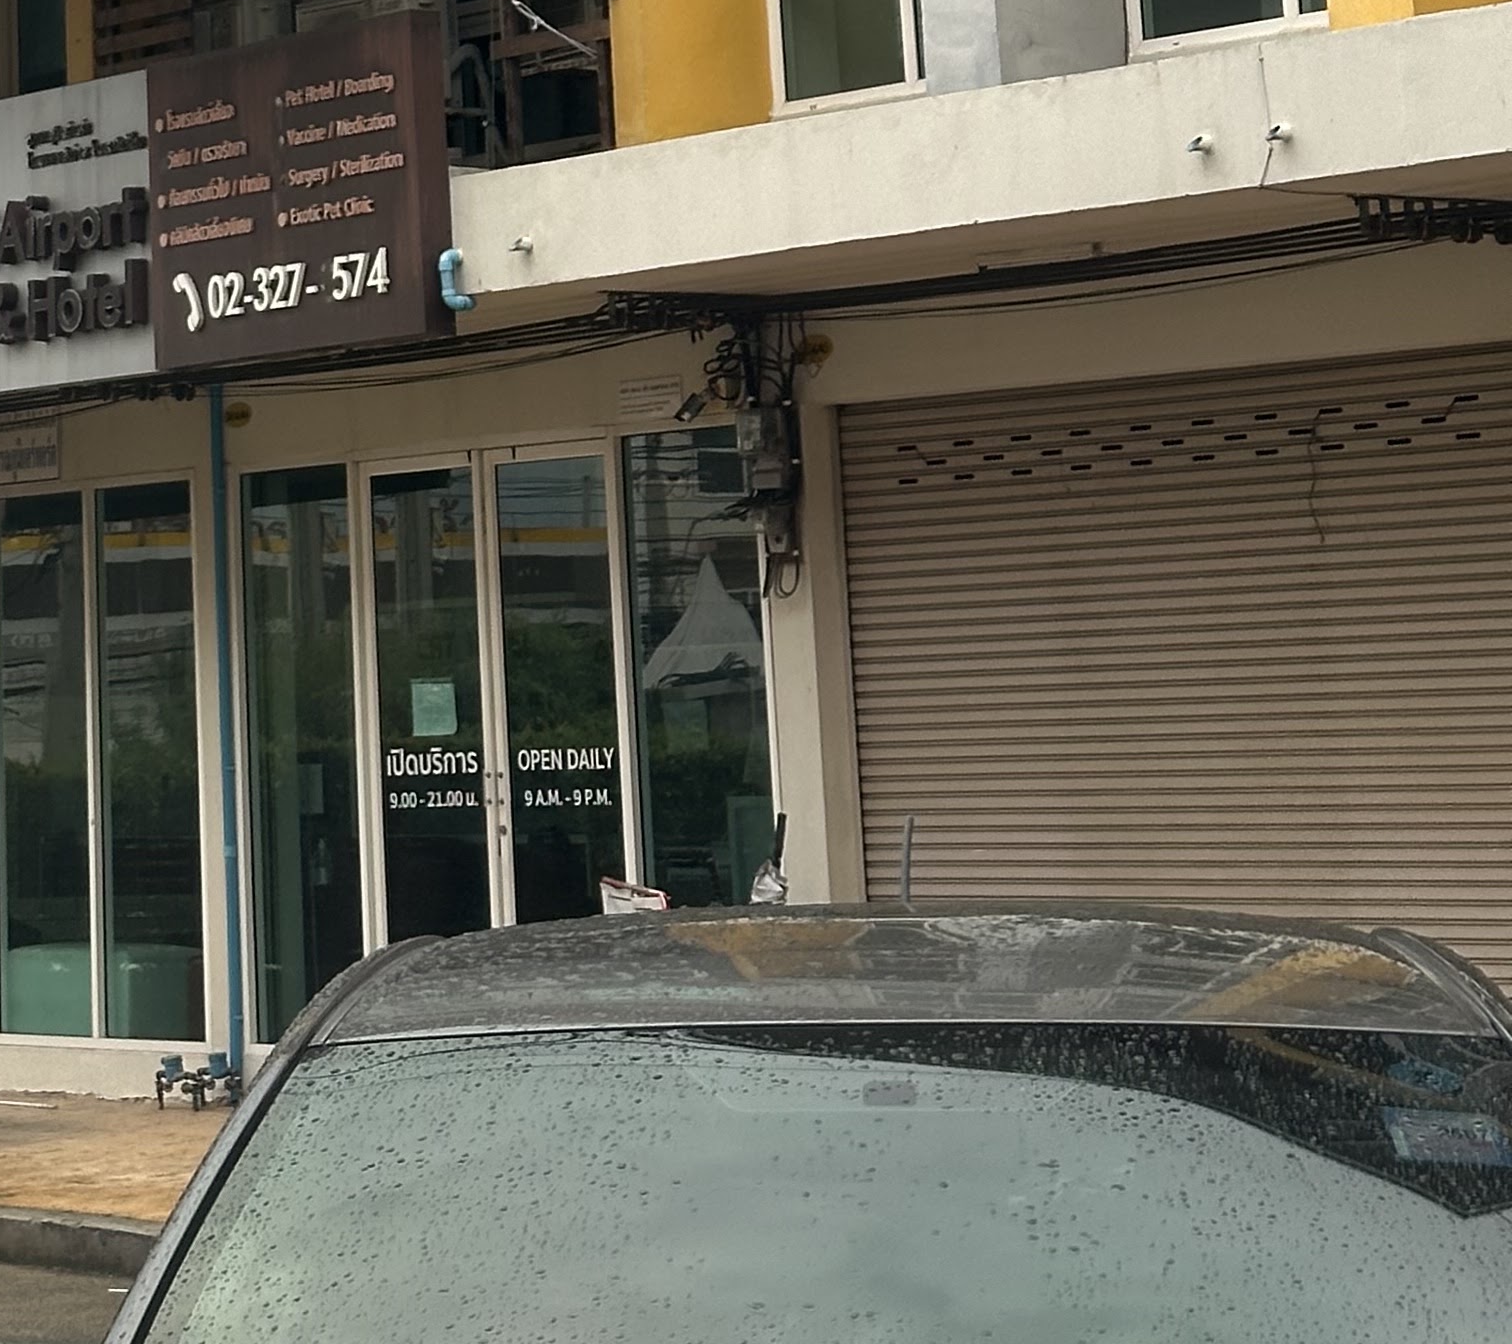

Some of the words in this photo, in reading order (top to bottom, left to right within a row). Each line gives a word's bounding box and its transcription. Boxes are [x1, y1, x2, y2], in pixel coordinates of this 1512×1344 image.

[285, 88, 304, 108] Pet
[305, 80, 335, 104] Hotel
[344, 71, 394, 97] Boarding
[287, 124, 327, 146] Vaccine
[336, 112, 396, 137] Medication
[288, 167, 329, 188] Surgery
[339, 151, 405, 177] Sterilization
[290, 203, 322, 225] Exotic
[323, 201, 342, 219] Pet
[344, 195, 376, 217] Clinic
[27, 258, 149, 342] Hotel
[387, 747, 479, 777] เปิดบริการ
[517, 749, 563, 771] OPEN
[567, 747, 615, 771] DAILY
[390, 792, 418, 809] 9.00
[427, 790, 464, 808] 21.00
[524, 790, 534, 807] 9
[535, 788, 564, 807] A.M.
[572, 788, 582, 806] 9
[584, 788, 613, 806] P.M.
